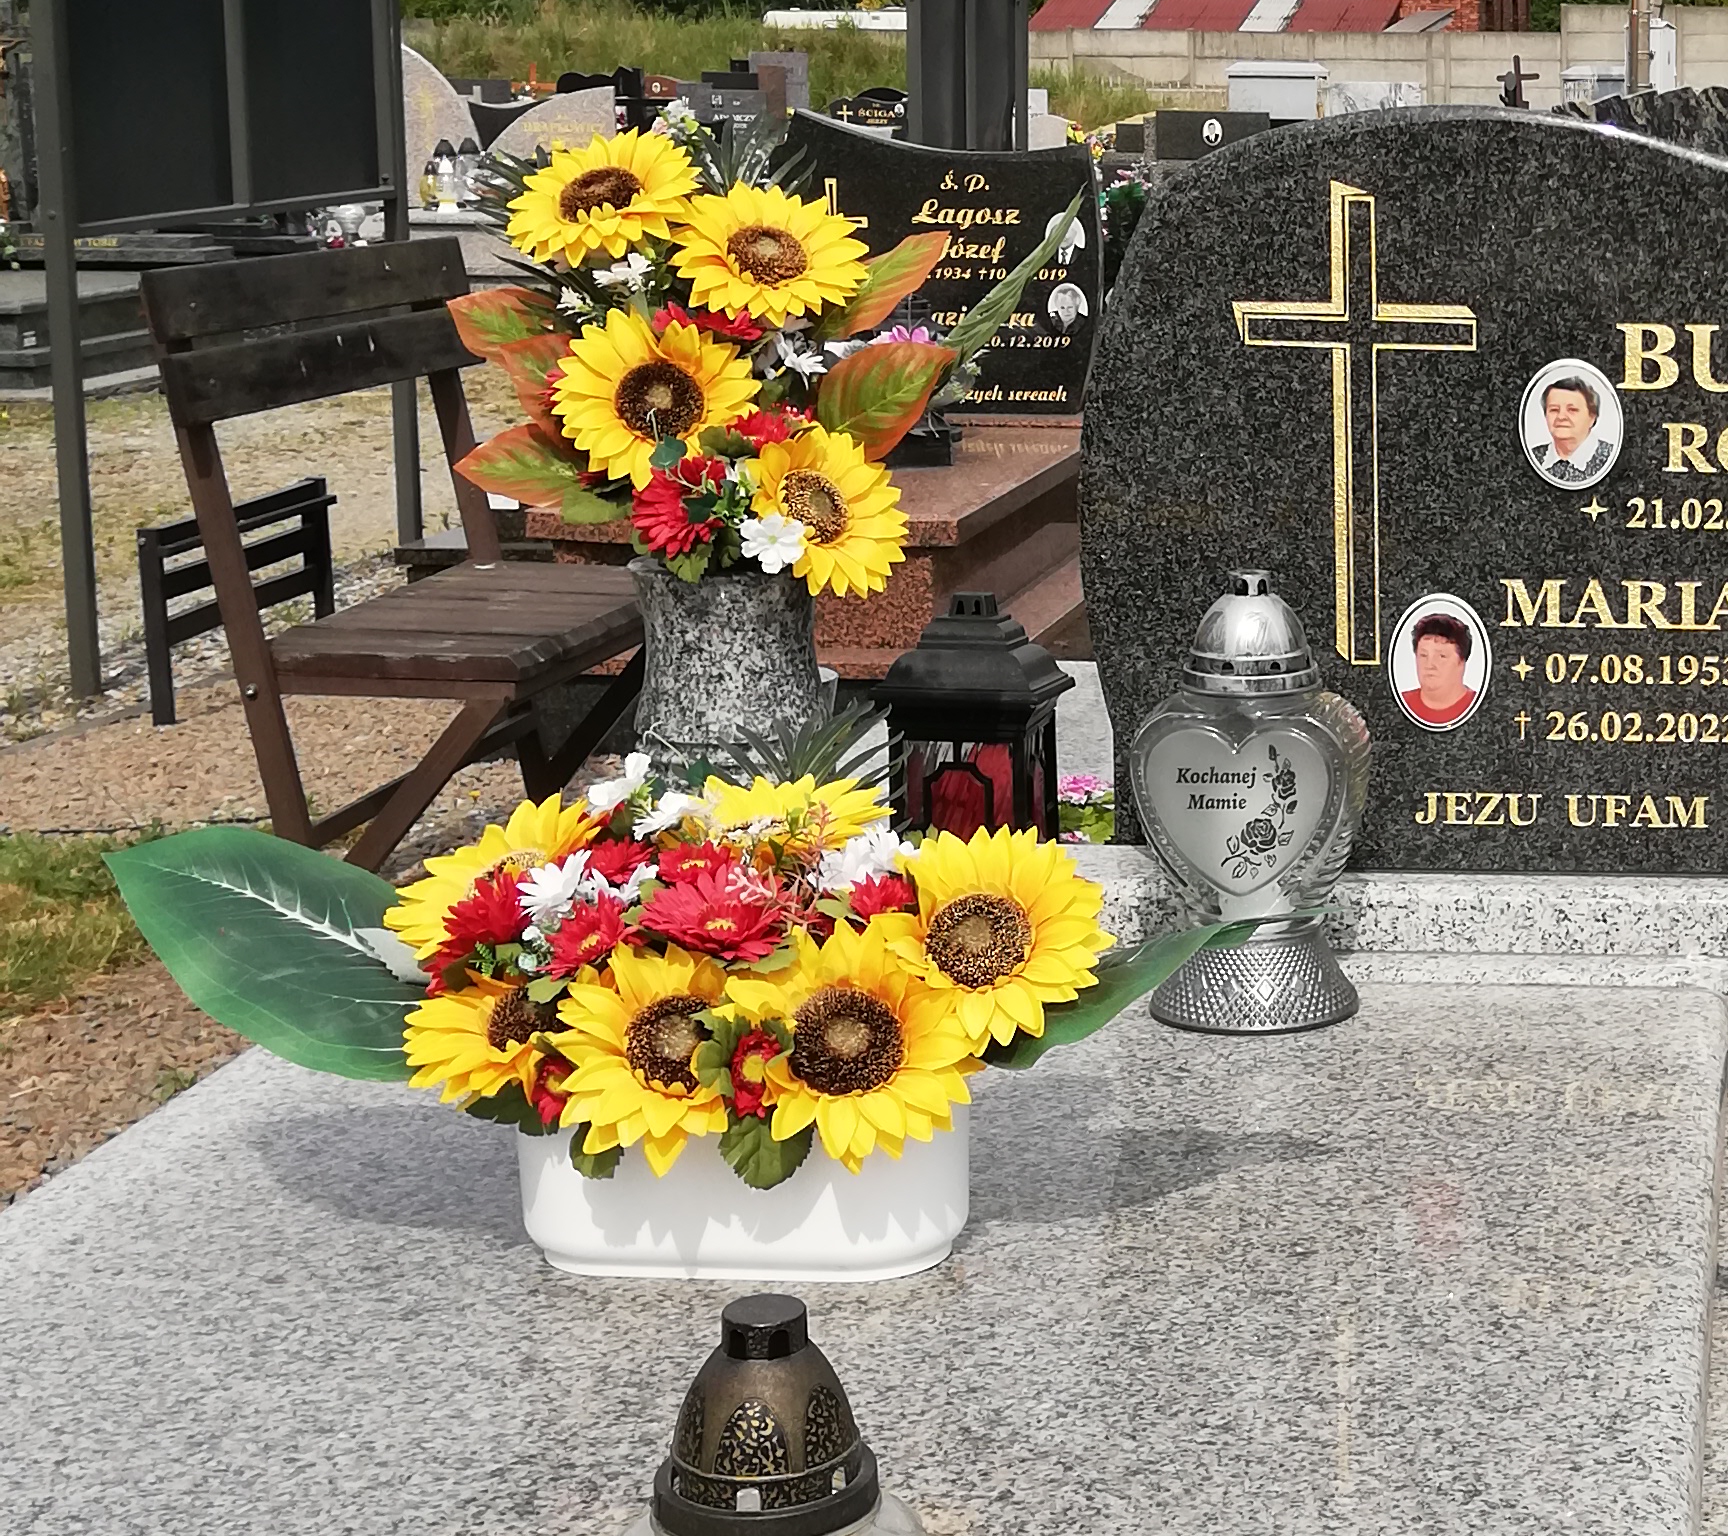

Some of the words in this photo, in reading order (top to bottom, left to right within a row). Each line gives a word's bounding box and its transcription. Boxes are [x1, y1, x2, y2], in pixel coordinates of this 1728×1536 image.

[984, 336, 1071, 348] 0.12.2019
[965, 384, 1003, 404] zych
[1176, 766, 1257, 789] Kochanej
[1187, 793, 1247, 810] Mamie
[1415, 791, 1543, 828] JEZU
[1565, 794, 1709, 830] UFAM
